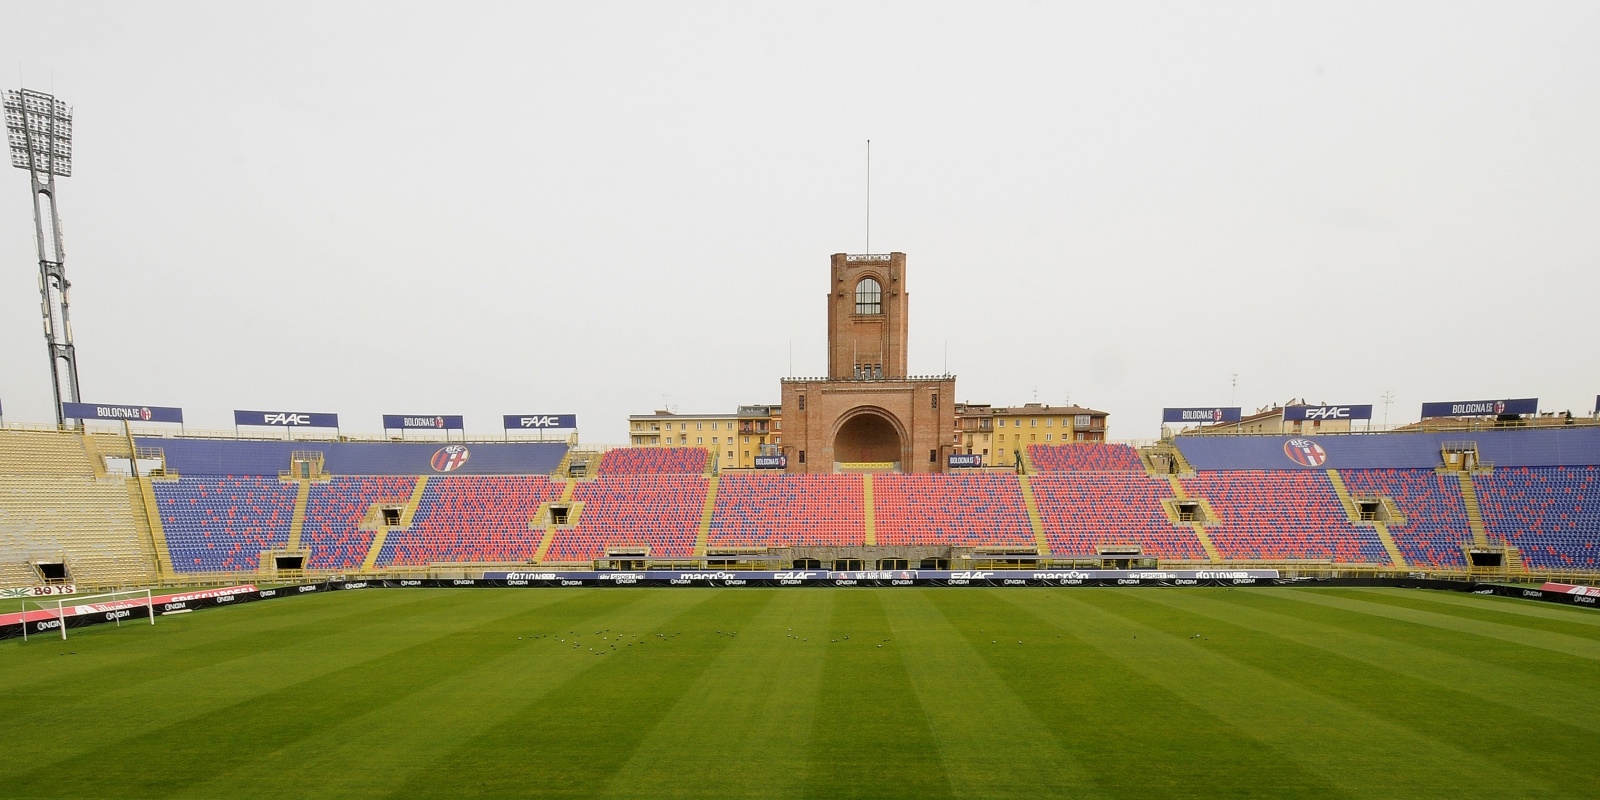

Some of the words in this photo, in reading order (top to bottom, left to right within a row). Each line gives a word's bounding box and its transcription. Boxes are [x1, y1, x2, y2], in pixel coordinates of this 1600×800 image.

[97, 406, 133, 418] BOLOGNA
[1305, 407, 1350, 419] FAAC
[1452, 403, 1486, 414] BOLOGNA
[264, 413, 310, 425] FAAC
[1182, 410, 1208, 420] BOLOGNA
[404, 417, 430, 426] BOLOGNA
[520, 416, 559, 427] FAAC
